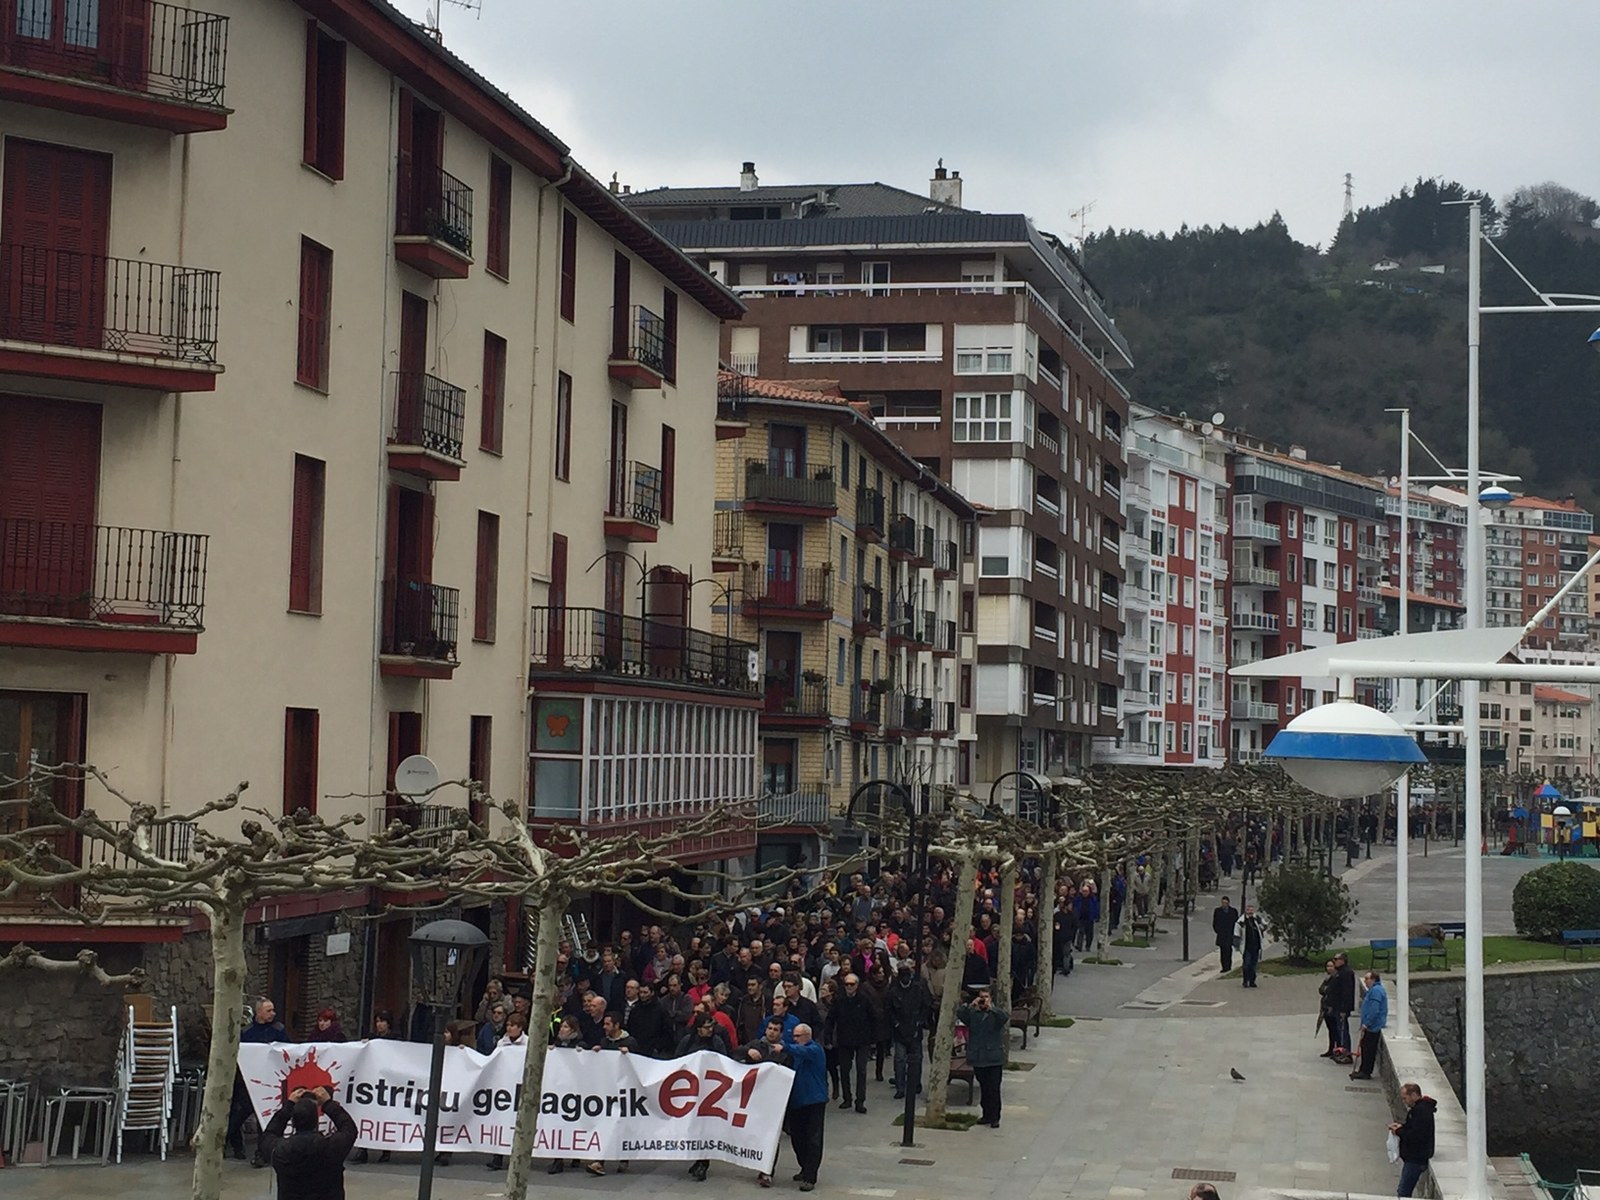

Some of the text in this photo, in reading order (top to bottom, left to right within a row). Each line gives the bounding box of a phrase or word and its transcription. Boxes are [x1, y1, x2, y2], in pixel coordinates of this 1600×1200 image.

[346, 1067, 760, 1128] istripu geagorik ez!
[480, 1124, 601, 1151] HILAILEA
